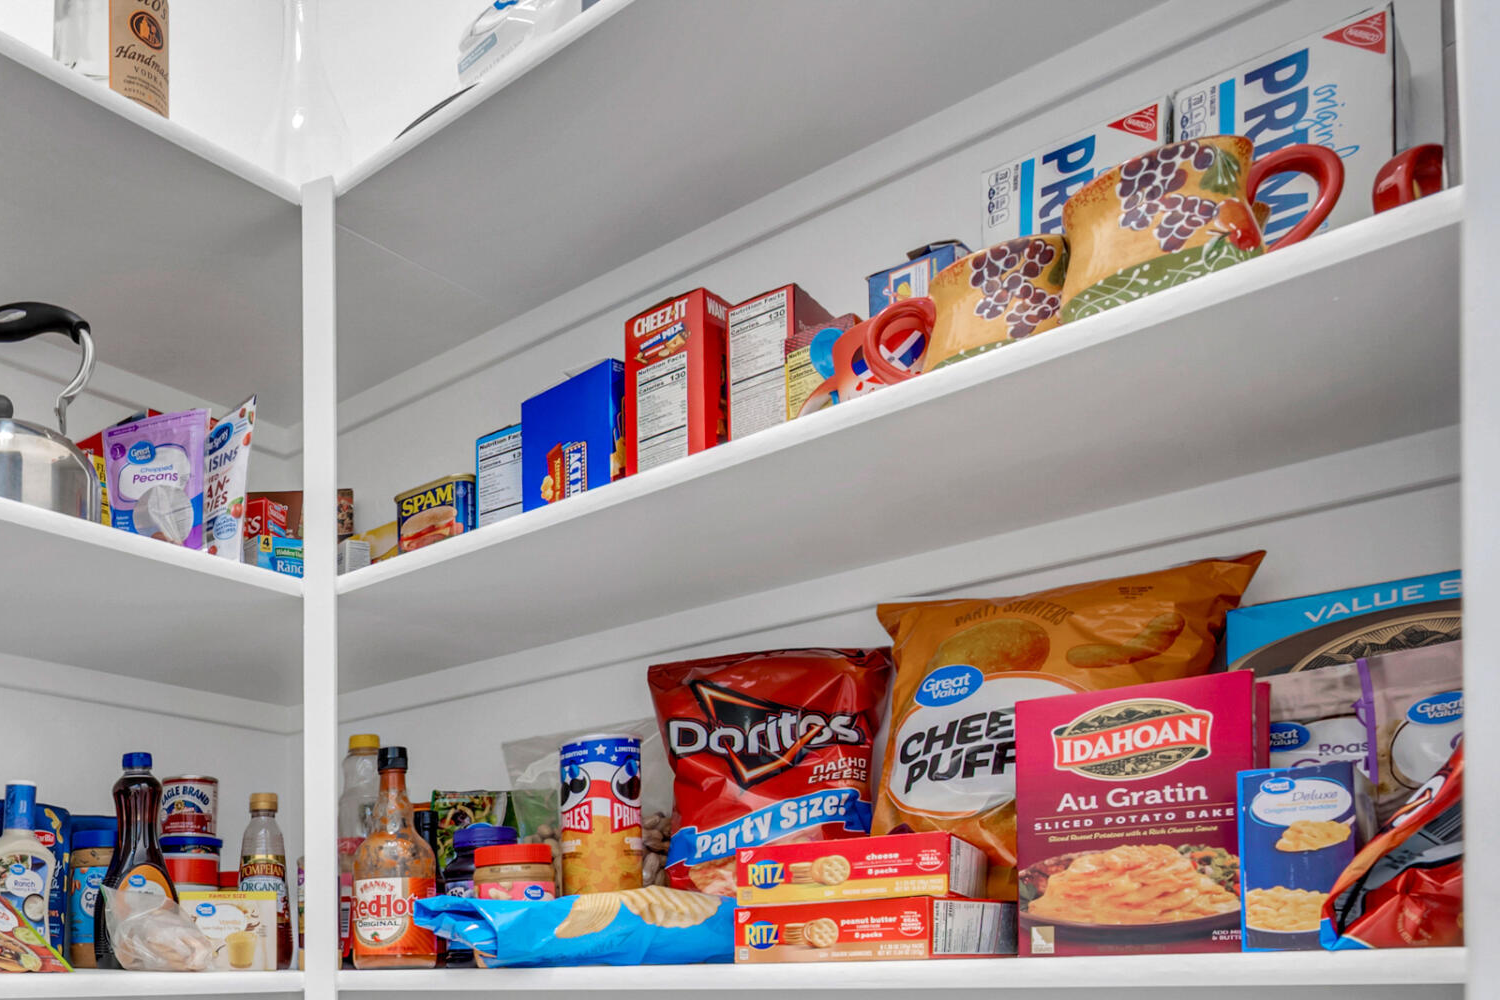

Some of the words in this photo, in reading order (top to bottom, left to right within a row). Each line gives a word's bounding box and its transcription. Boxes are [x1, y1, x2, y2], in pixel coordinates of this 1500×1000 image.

[133, 472, 178, 484] Pecans
[401, 483, 454, 518] SPAM
[1304, 584, 1424, 624] VALUE
[921, 672, 972, 693] Great
[932, 684, 969, 700] Value
[668, 706, 860, 759] Doritos
[1062, 718, 1201, 764] IDAHOAN
[812, 757, 867, 774] NACHO
[807, 770, 867, 785] CHEESE
[1056, 793, 1098, 813] Au
[1106, 783, 1209, 808] Gratin
[1292, 790, 1338, 802] Deluxe
[695, 806, 774, 859] Party
[779, 790, 850, 829] Size!
[1034, 818, 1094, 831] SLICED
[1104, 812, 1176, 825] POTATO
[1186, 808, 1235, 819] BAKE
[1048, 835, 1069, 843] Sliced
[1093, 831, 1124, 840] Potatoes
[1126, 830, 1141, 838] with
[1168, 826, 1193, 835] Cheese
[866, 852, 899, 861] cheese
[241, 864, 284, 876] POMPEIAN
[747, 862, 785, 886] RITZ
[14, 881, 35, 889] Ranch
[241, 881, 284, 892] ORGANIC
[359, 881, 394, 894] FRANK'S
[358, 920, 400, 928] ORIGINAL
[840, 917, 869, 927] peanut
[870, 916, 897, 924] butter
[744, 924, 779, 945] RITZ
